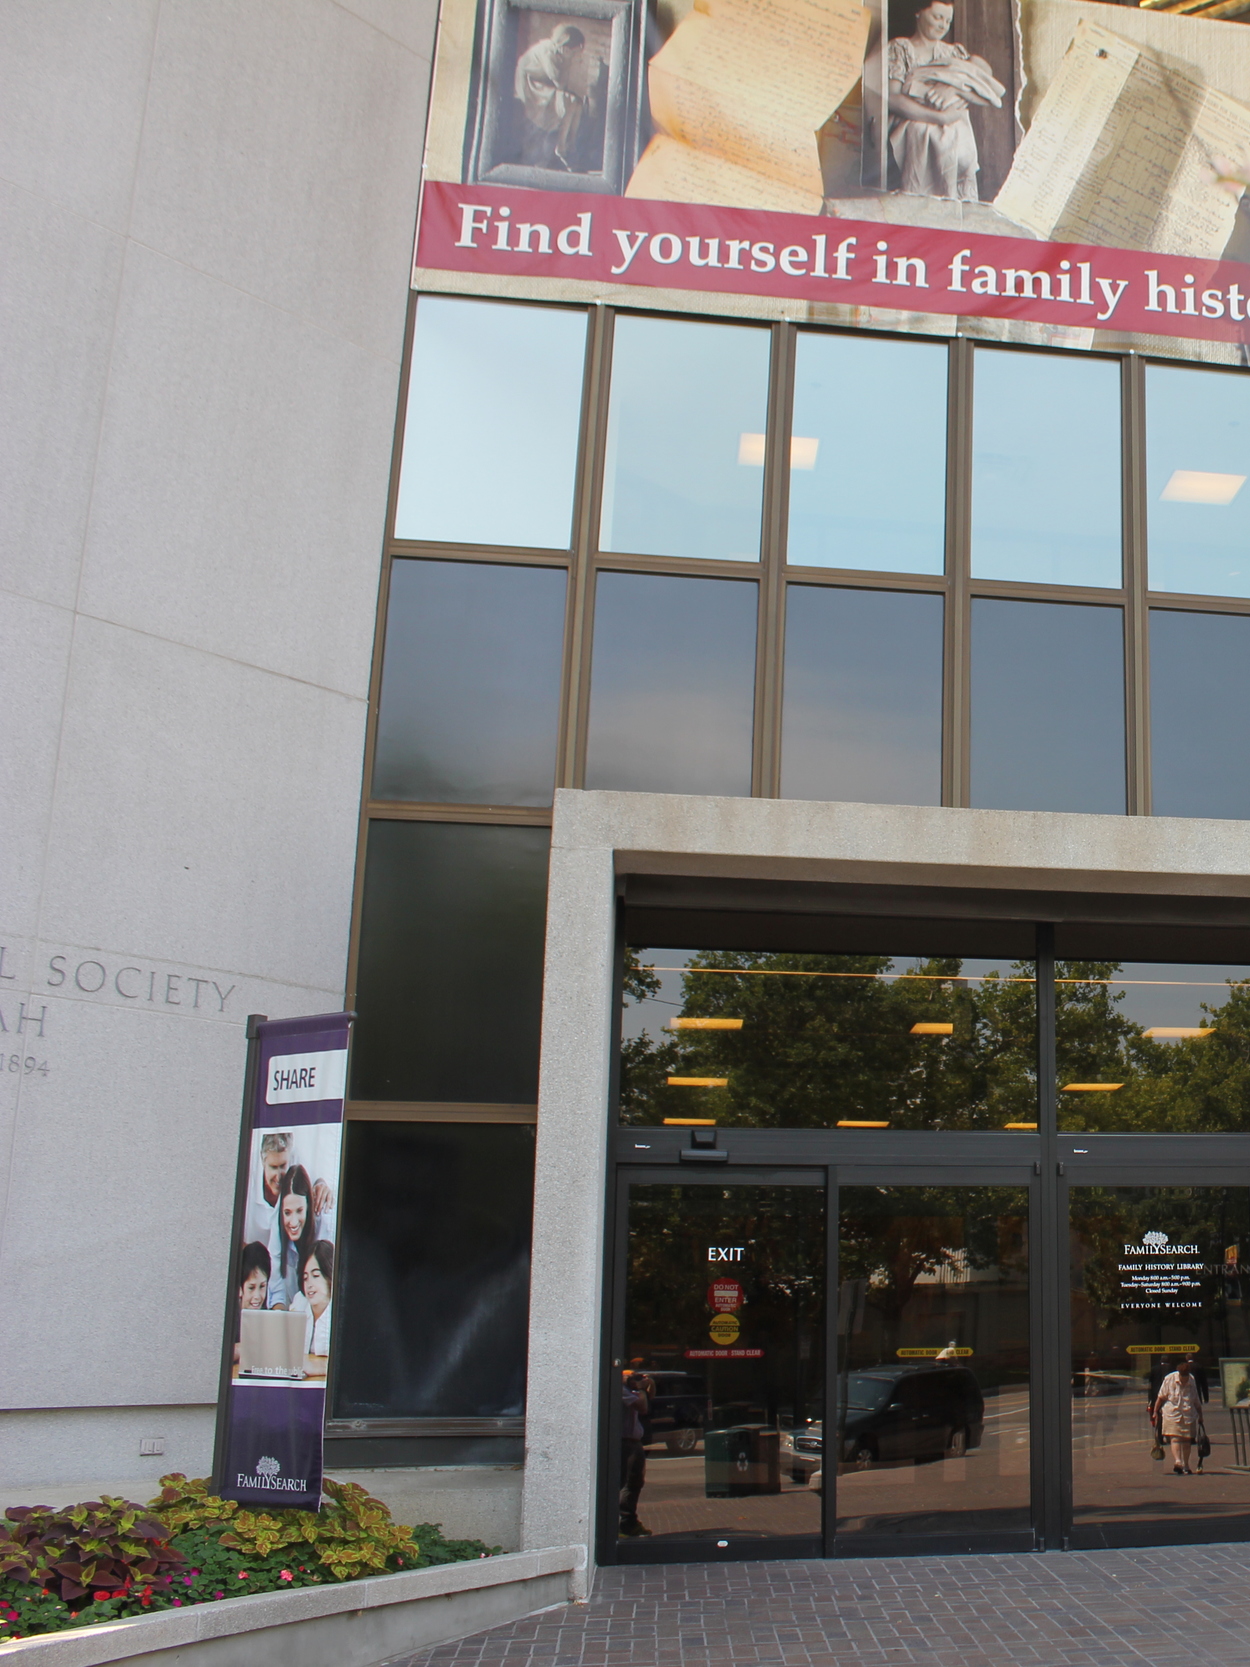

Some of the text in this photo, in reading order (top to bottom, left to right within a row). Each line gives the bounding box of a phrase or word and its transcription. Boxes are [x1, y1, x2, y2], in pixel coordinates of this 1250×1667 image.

[454, 202, 593, 257] Find
[610, 234, 857, 281] yourself
[871, 240, 929, 288] in
[947, 249, 1129, 320] family
[47, 955, 236, 1013] SOCIETY
[273, 1067, 316, 1091] SHARE
[708, 1247, 744, 1261] EXIT
[1118, 1262, 1204, 1271] FAMILY HISTORY LIBRARY
[265, 1366, 273, 1375] to
[275, 1366, 287, 1375] the
[237, 1473, 307, 1492] FAMILYSEARCH
